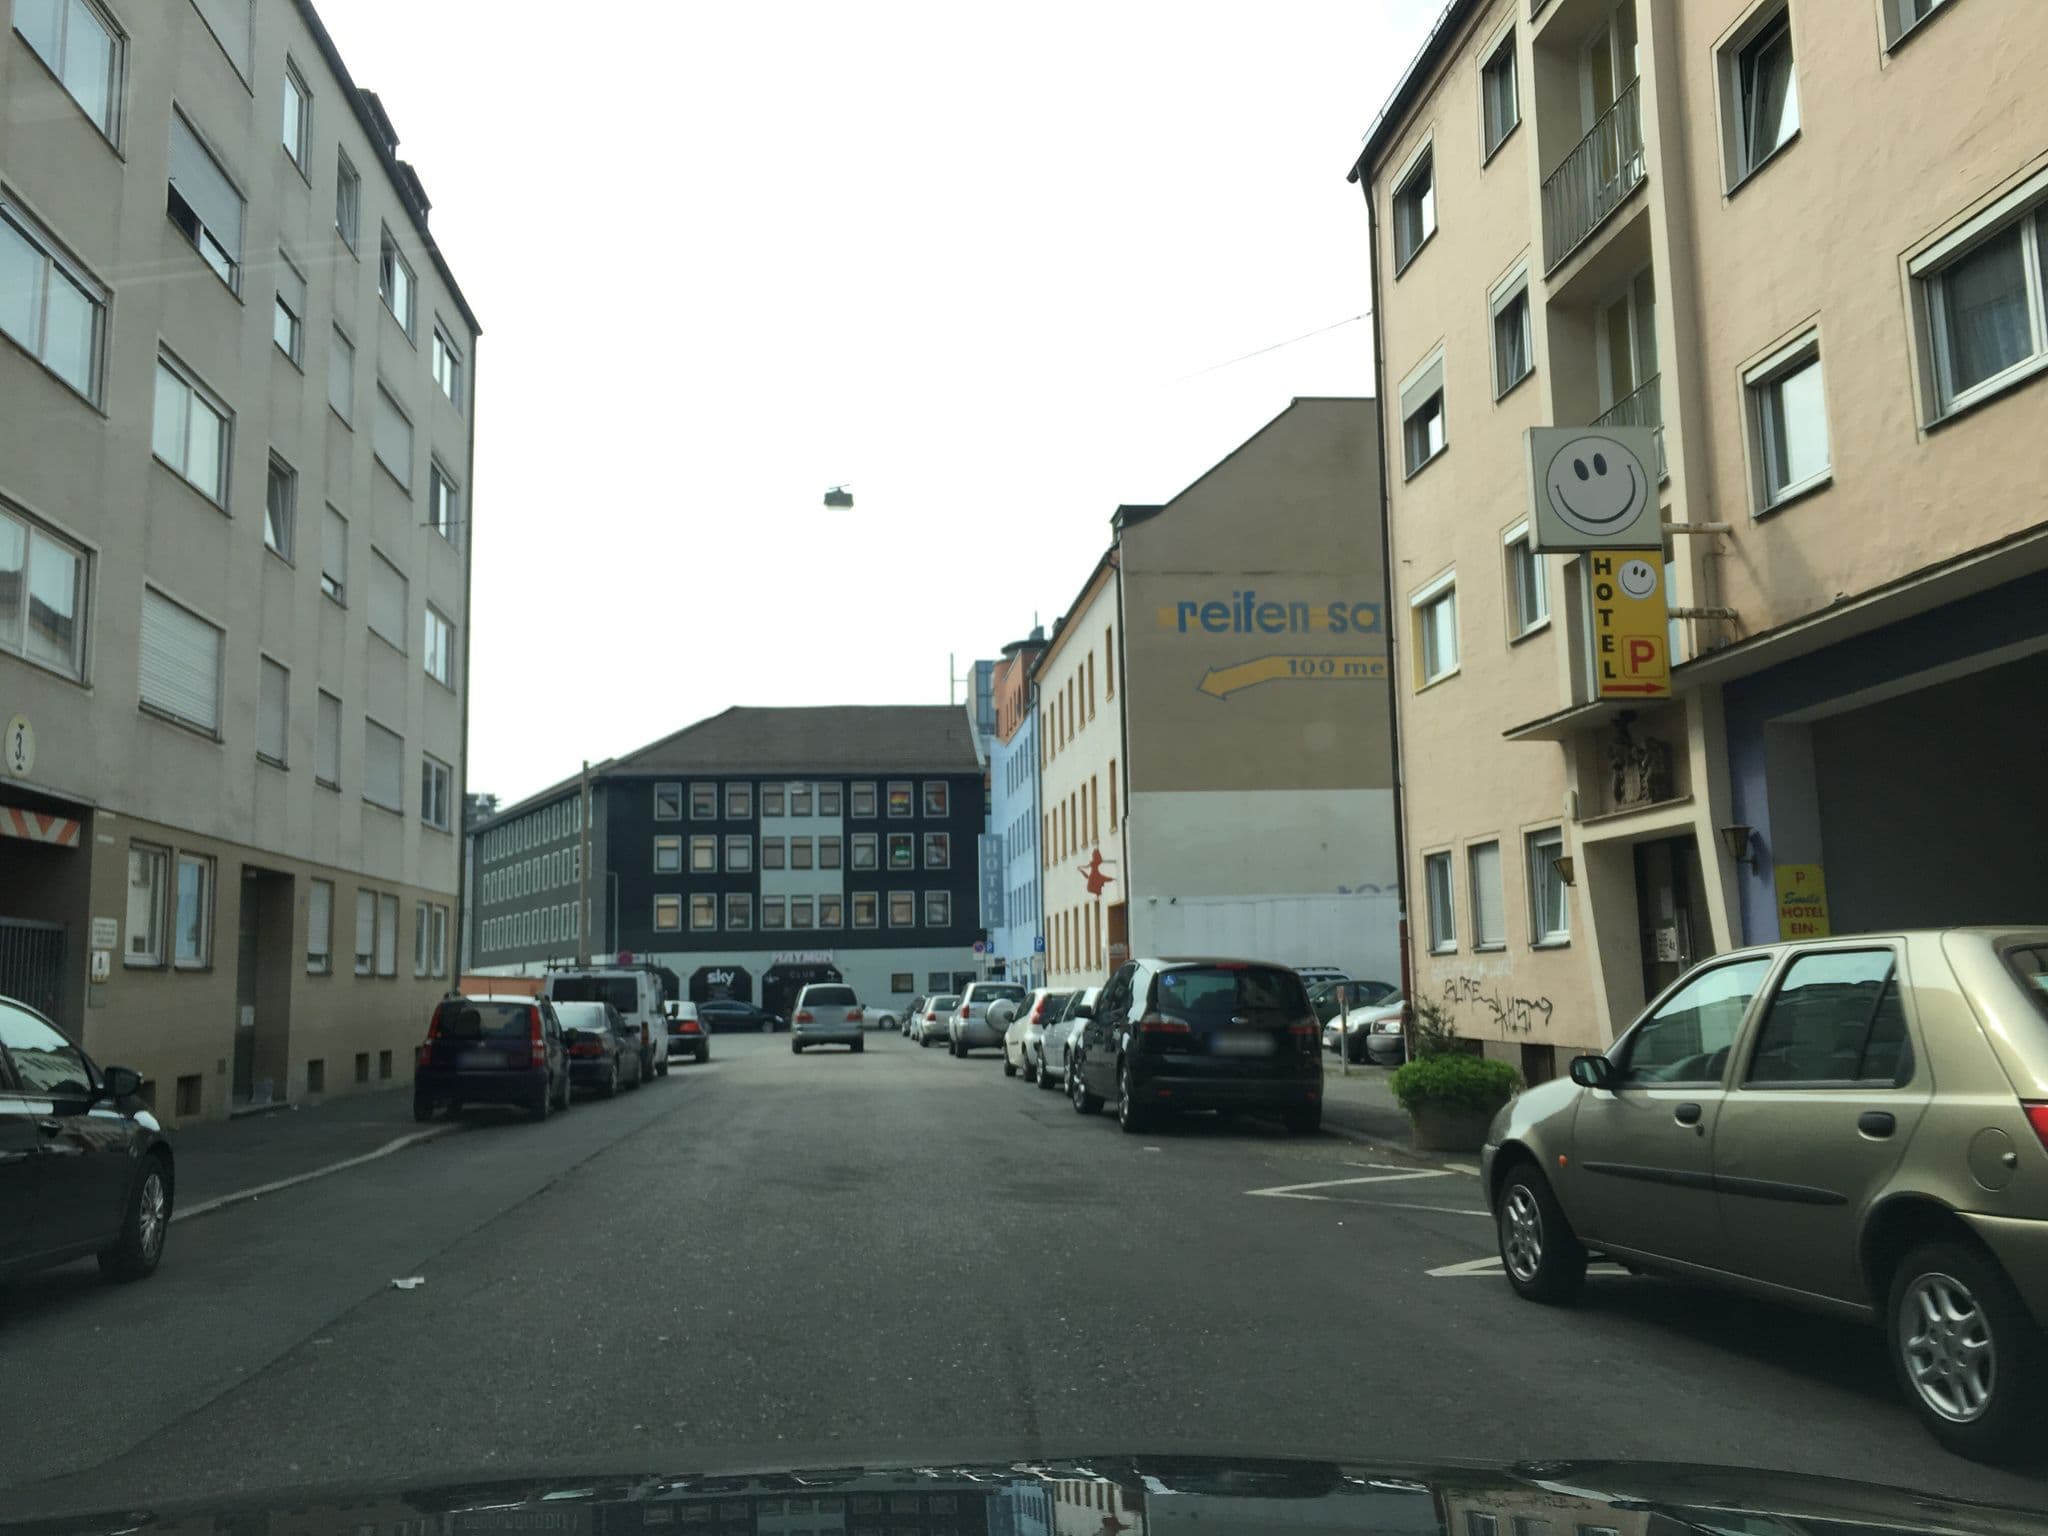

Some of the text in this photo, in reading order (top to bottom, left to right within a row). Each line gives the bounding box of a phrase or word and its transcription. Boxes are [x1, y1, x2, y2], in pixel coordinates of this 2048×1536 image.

[1177, 590, 1310, 634] reifen
[1594, 557, 1616, 679] HOTEL
[1630, 640, 1656, 674] P
[1287, 659, 1336, 675] 100
[985, 839, 999, 922] HOTEL
[1796, 871, 1805, 884] P
[1782, 906, 1825, 918] HOTEL
[1791, 922, 1819, 934] EIN-
[706, 968, 735, 987] sky
